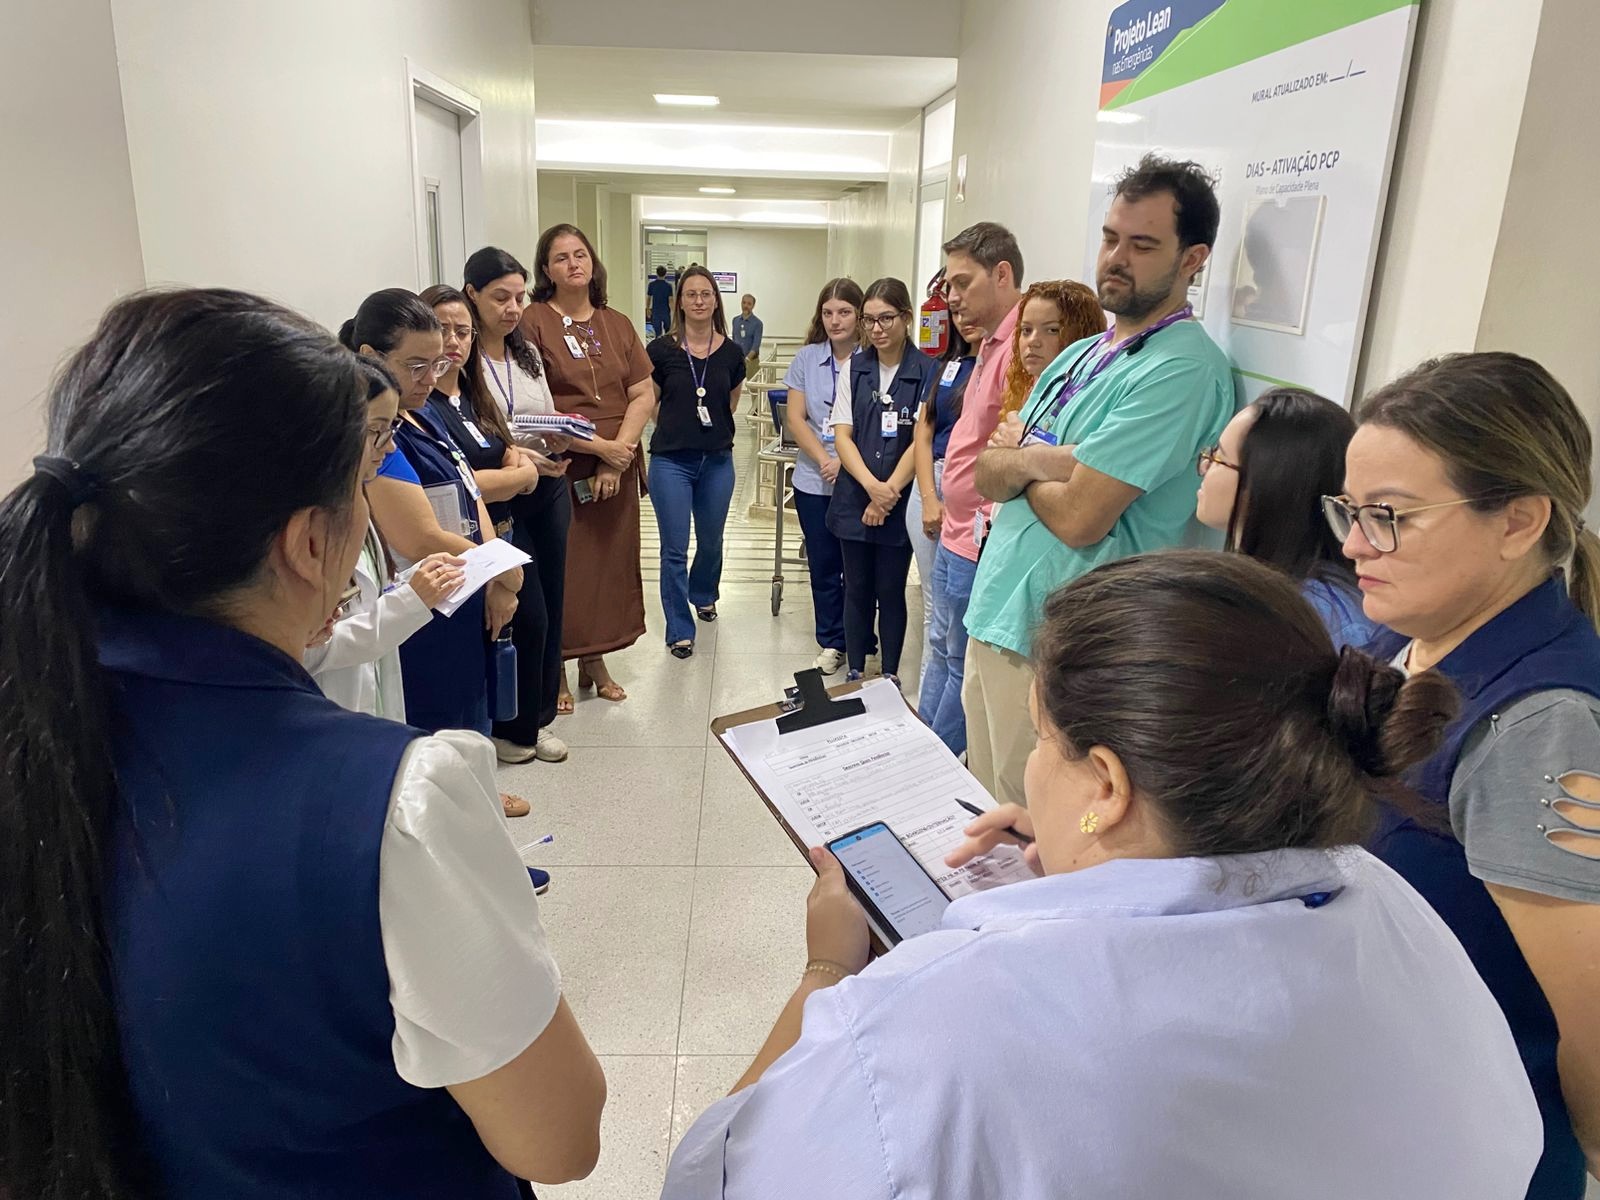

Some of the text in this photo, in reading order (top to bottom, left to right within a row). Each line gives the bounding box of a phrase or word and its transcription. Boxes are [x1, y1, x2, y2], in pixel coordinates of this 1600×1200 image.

[1113, 6, 1171, 55] Projeto Lean
[1112, 45, 1154, 76] nas Emergências
[1251, 87, 1272, 104] MURAL
[1273, 75, 1314, 97] ATUALIZADO
[1246, 161, 1265, 179] DIAS
[1271, 150, 1318, 177] ATIVAÇÃO
[1319, 150, 1340, 170] PCP
[1275, 181, 1304, 195] Capacidade
[1304, 179, 1320, 191] Plena
